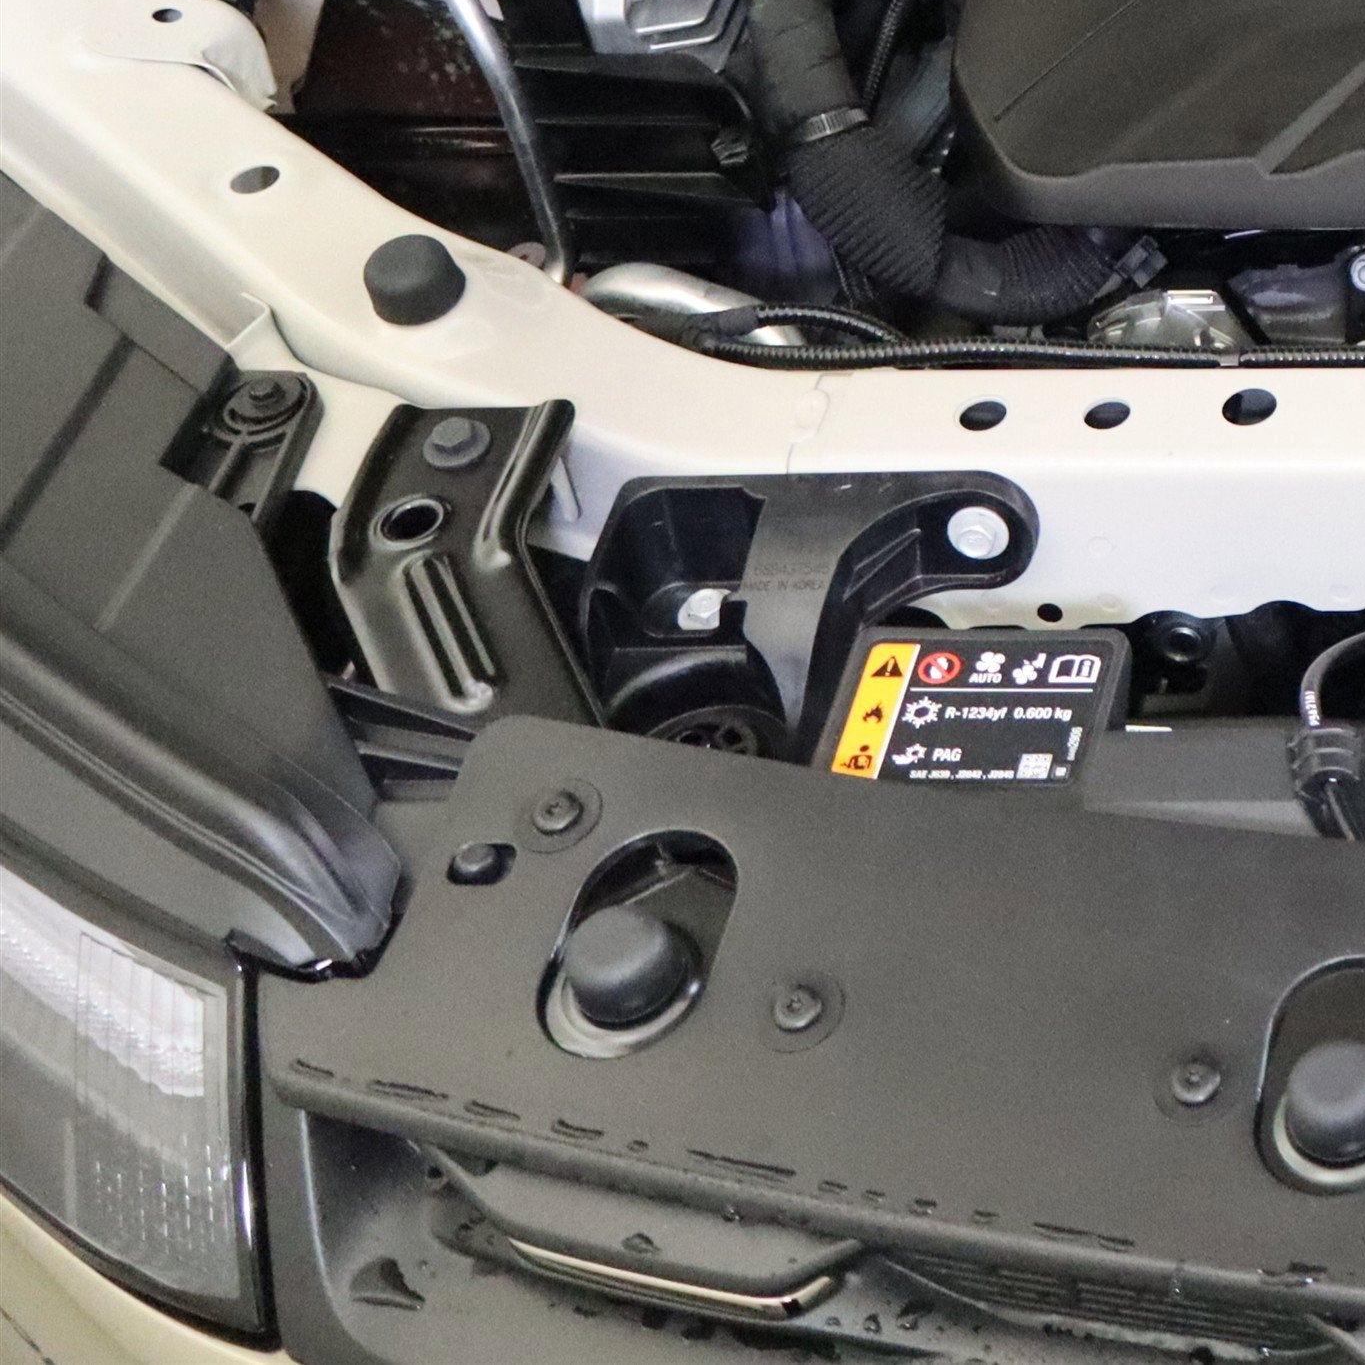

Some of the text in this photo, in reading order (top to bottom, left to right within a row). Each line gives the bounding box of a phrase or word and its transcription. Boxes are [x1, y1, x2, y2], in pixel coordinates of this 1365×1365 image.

[968, 673, 1002, 683] AUTO
[944, 707, 1073, 721] R-1234yf 0.600 kg
[932, 748, 962, 762] PAG
